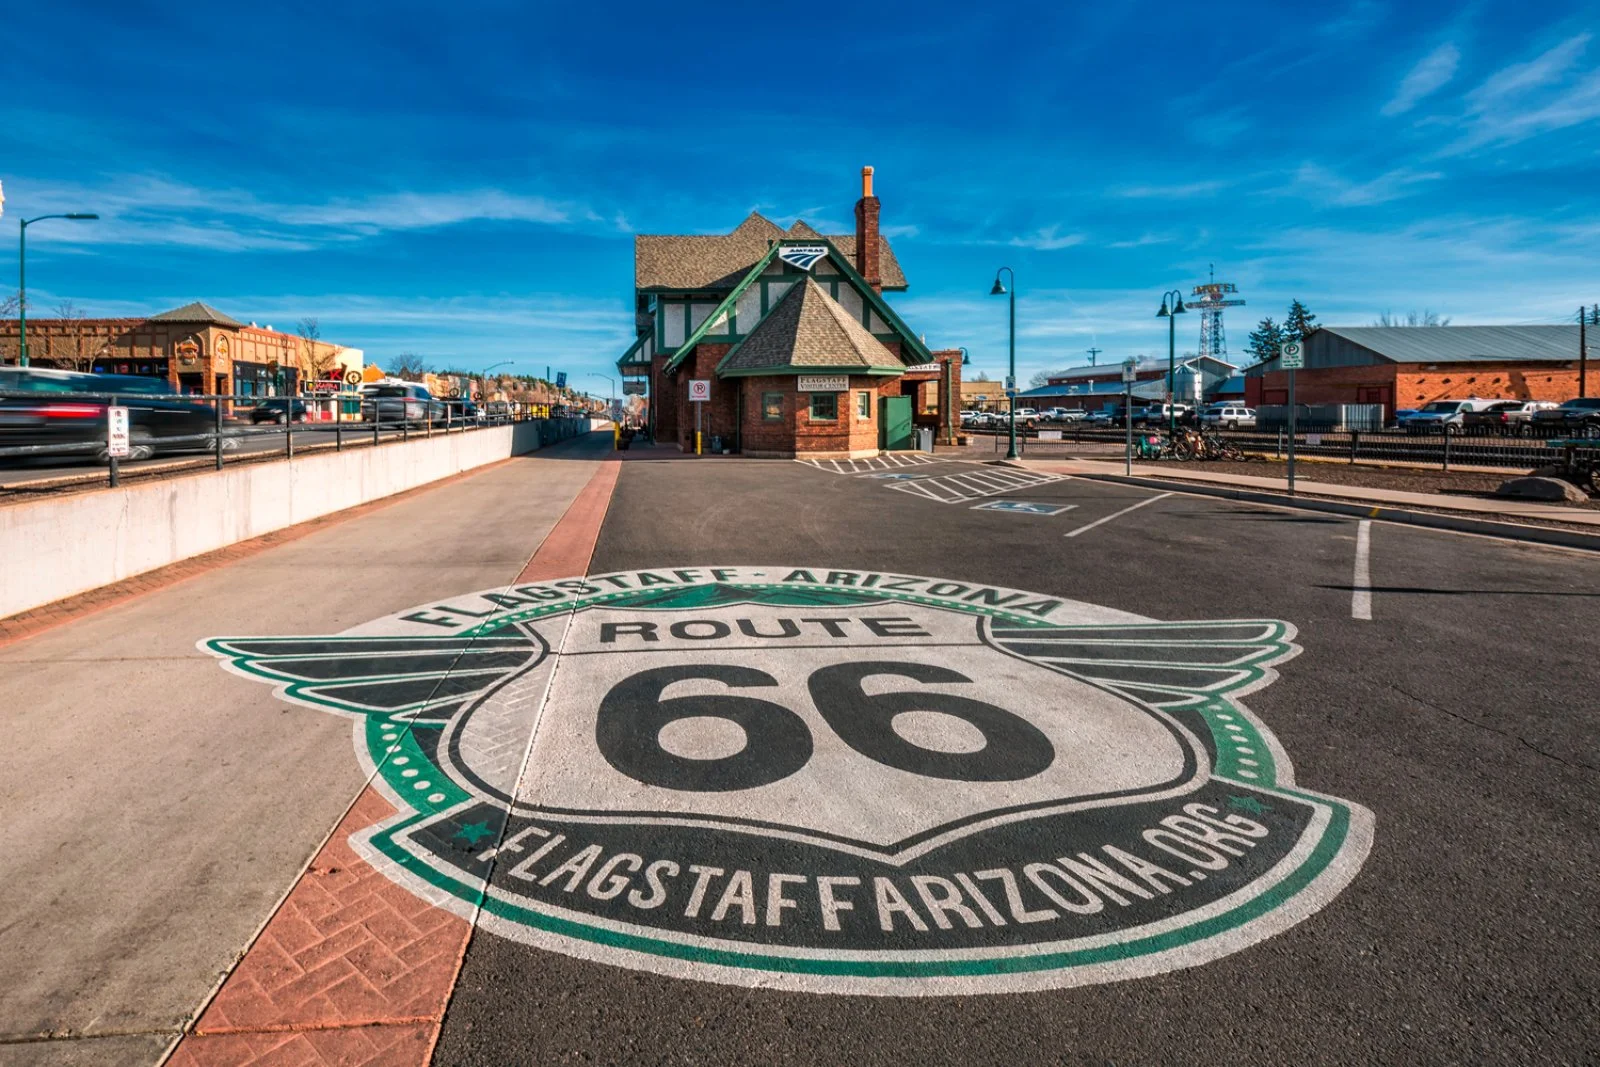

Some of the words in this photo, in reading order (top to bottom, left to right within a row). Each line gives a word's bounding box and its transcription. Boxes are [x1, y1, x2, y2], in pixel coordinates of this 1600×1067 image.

[800, 376, 847, 384] FLAGSTAFF
[398, 568, 739, 628] FLAGSTAFF
[782, 569, 1064, 617] ARIZONA
[600, 617, 932, 643] ROUTE
[595, 660, 1056, 793] 66
[476, 803, 1270, 932] FLAGSTAFFARIZONA.ORG
